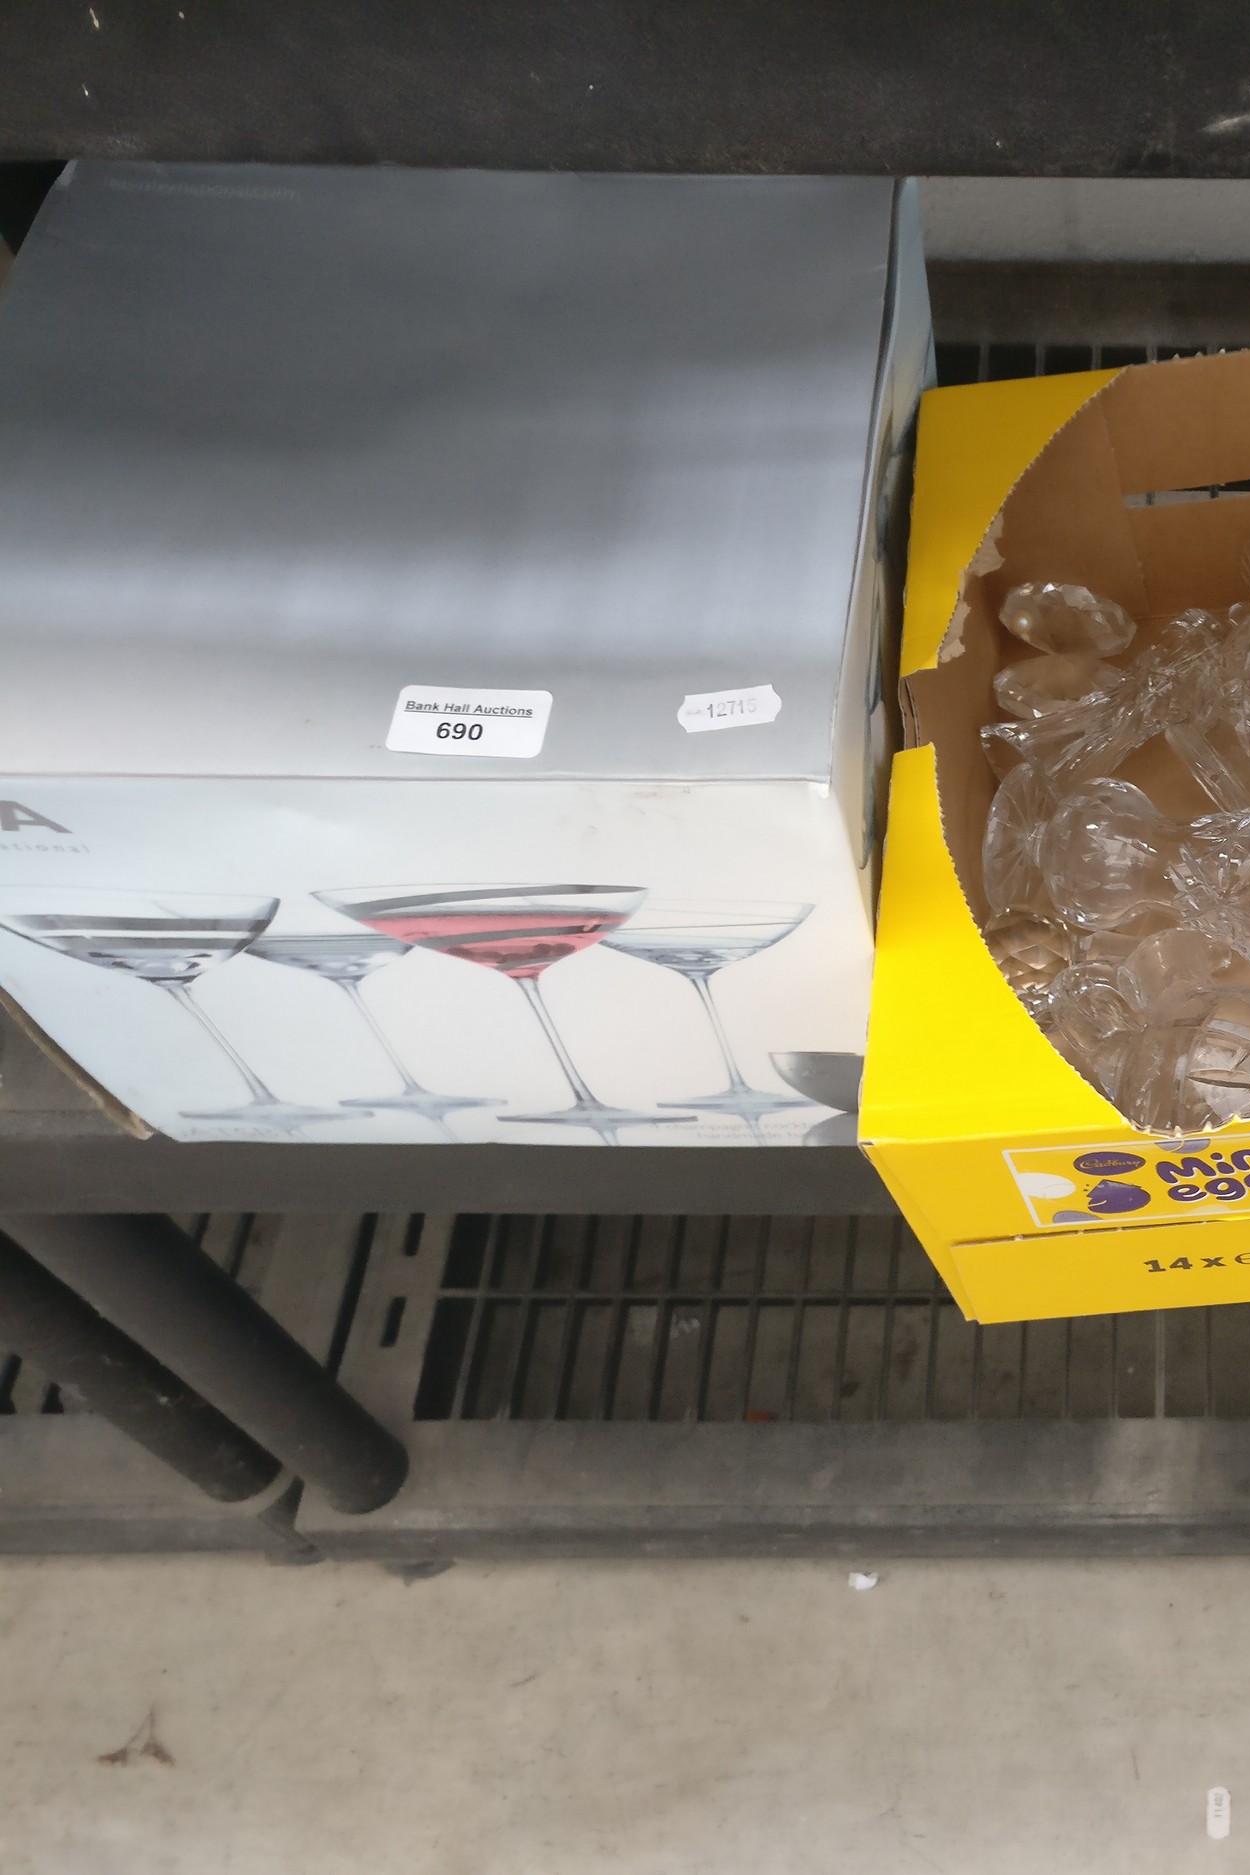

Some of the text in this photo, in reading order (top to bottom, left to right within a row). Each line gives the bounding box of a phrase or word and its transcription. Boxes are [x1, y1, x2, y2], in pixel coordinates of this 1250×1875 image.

[405, 700, 534, 717] Bank Hall Auctions
[436, 722, 484, 741] 690
[1079, 1157, 1142, 1170] Cadbury
